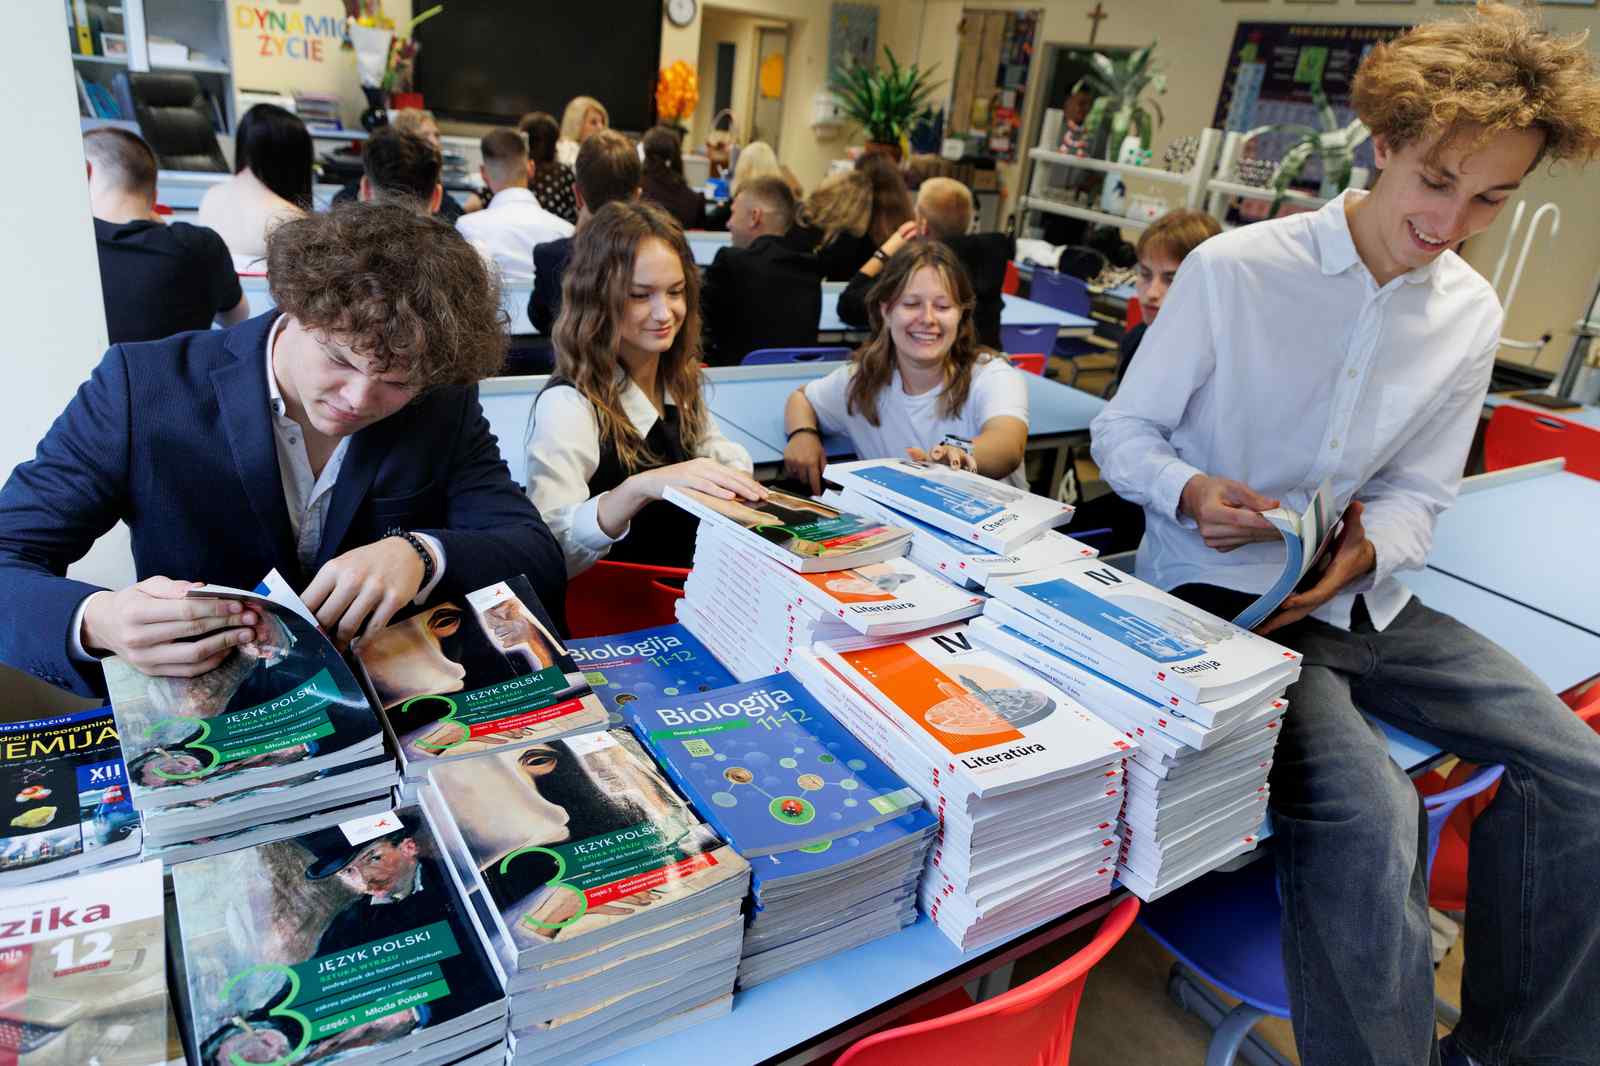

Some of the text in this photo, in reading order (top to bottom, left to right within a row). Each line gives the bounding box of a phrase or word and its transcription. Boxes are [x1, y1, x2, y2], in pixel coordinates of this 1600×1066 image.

[1083, 568, 1123, 586] IV
[567, 636, 683, 662] Biologija
[931, 631, 973, 654] IV
[648, 650, 697, 667] 11-12
[1171, 658, 1221, 674] Chemija
[502, 673, 544, 691] POLSKI
[271, 682, 318, 710] POLSKI
[656, 689, 794, 726] Biologija
[756, 708, 814, 731] 11-12
[0, 726, 120, 760] EMIJA
[89, 764, 120, 781] XII
[615, 824, 658, 842] POLSK
[0, 903, 111, 940] zika
[51, 931, 113, 972] 12
[317, 931, 431, 974] JĘZYK POLSKI
[398, 991, 429, 1006] Polska
